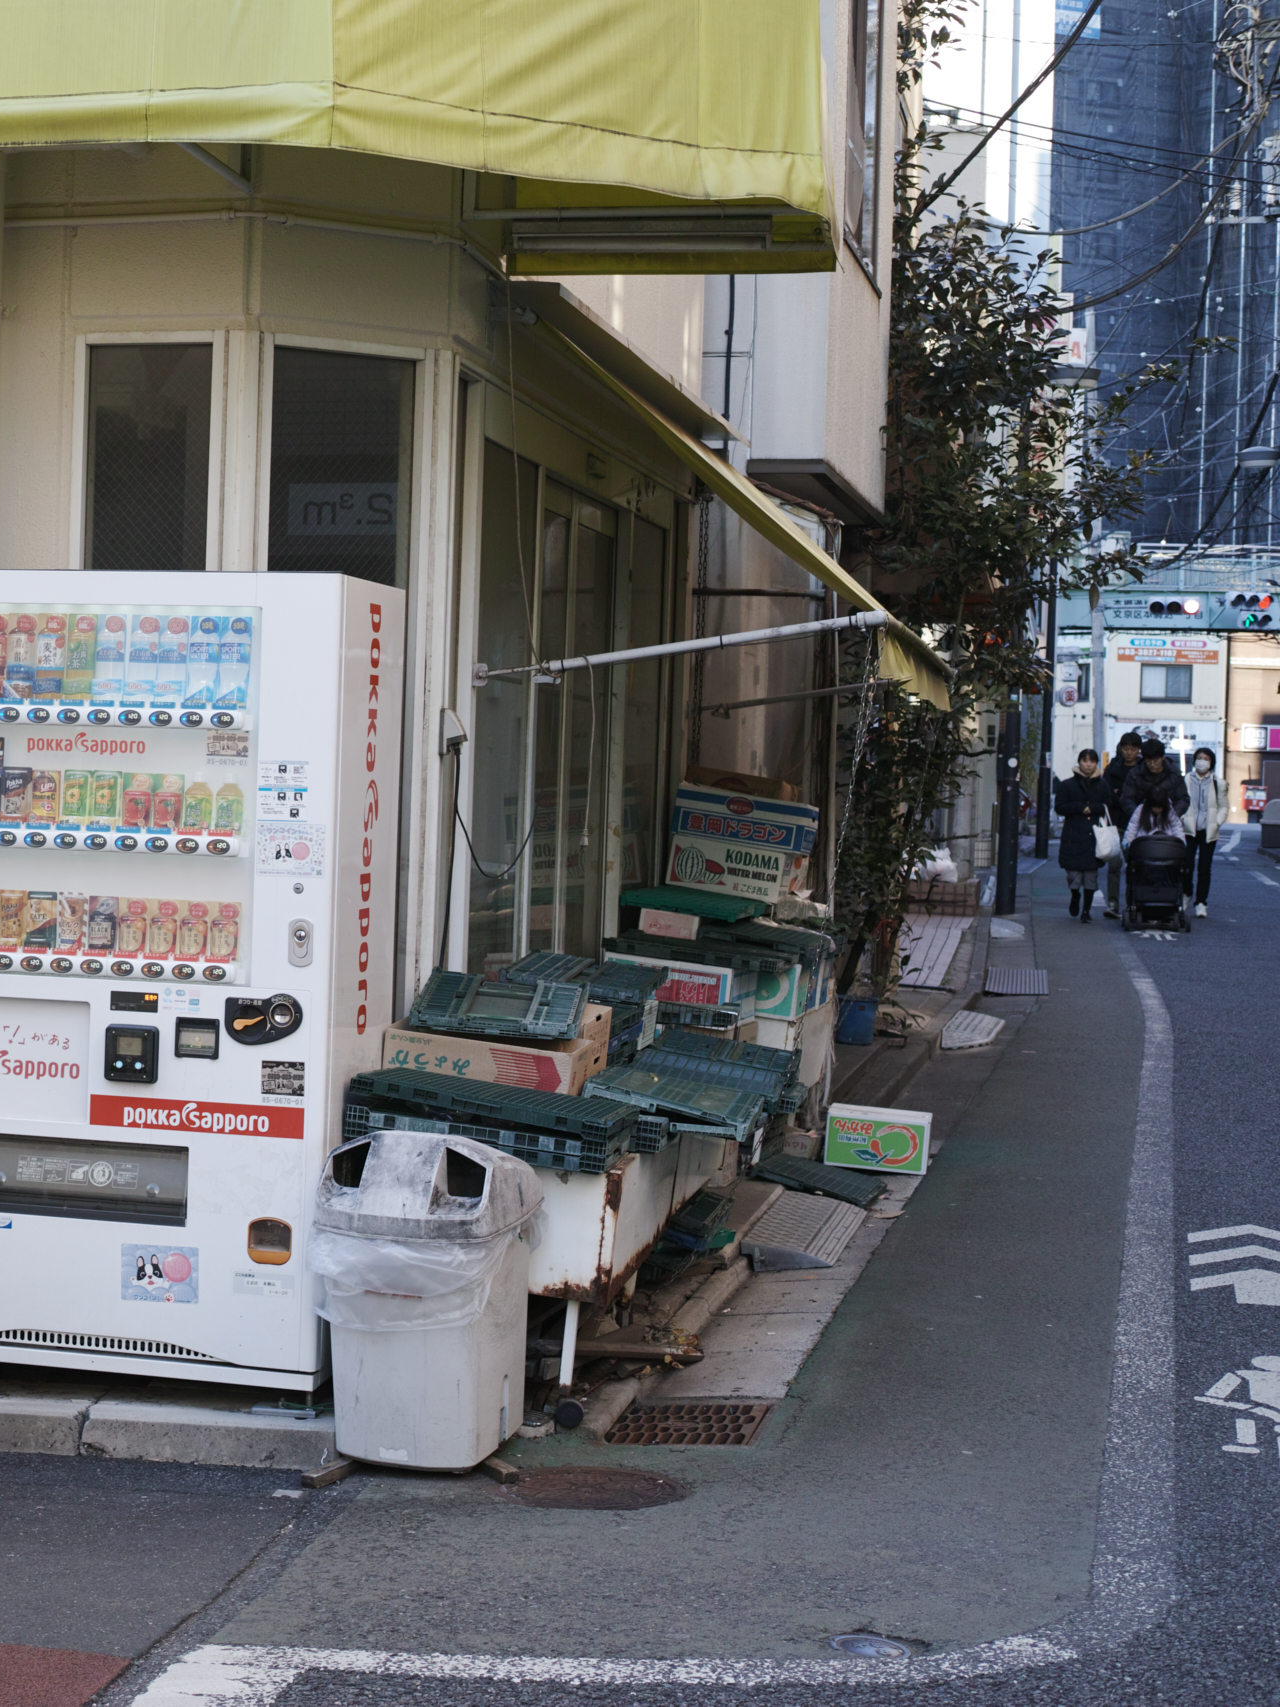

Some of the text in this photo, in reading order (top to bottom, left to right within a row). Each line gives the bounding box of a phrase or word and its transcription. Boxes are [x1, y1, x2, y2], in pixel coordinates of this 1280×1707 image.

[43, 642, 52, 665] 麦茶
[1065, 690, 1076, 703] 薬
[6, 779, 23, 787] Pokka
[688, 813, 787, 842] 豊岡ドラゴン
[725, 849, 779, 872] KODAMA
[726, 866, 778, 883] WATER MELON
[740, 884, 769, 897] こだま西瓜
[388, 1050, 470, 1076] みょうが
[262, 1096, 303, 1105] 85-0670-01
[833, 1119, 873, 1135] みかん
[838, 1134, 867, 1143] 紀州有田
